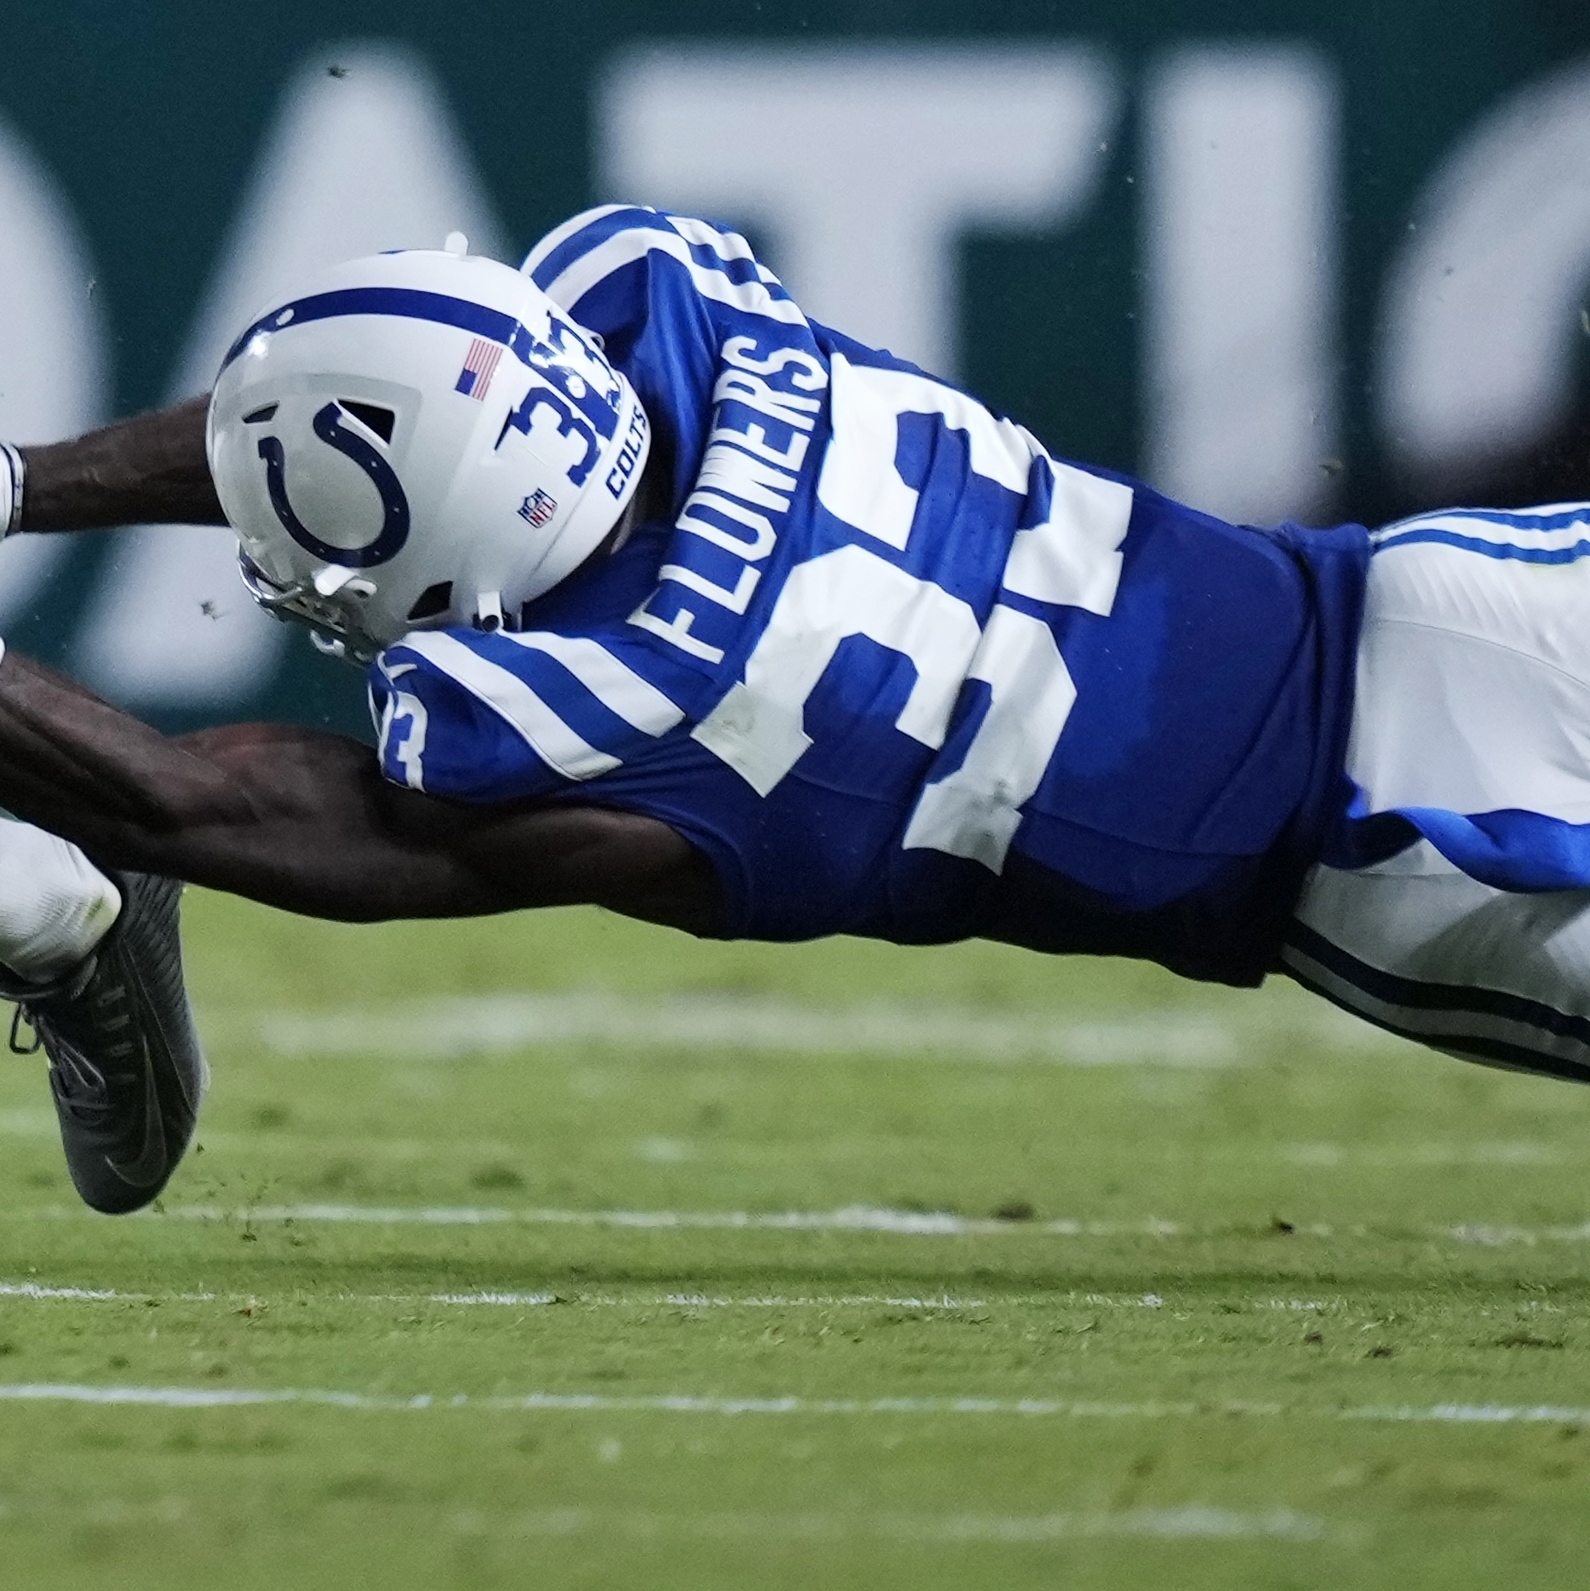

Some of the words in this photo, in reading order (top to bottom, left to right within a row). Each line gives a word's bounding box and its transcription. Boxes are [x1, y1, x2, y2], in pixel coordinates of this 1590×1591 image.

[605, 405, 647, 501] COLTS
[626, 336, 829, 664] FLOWERS
[690, 353, 1134, 877] 33
